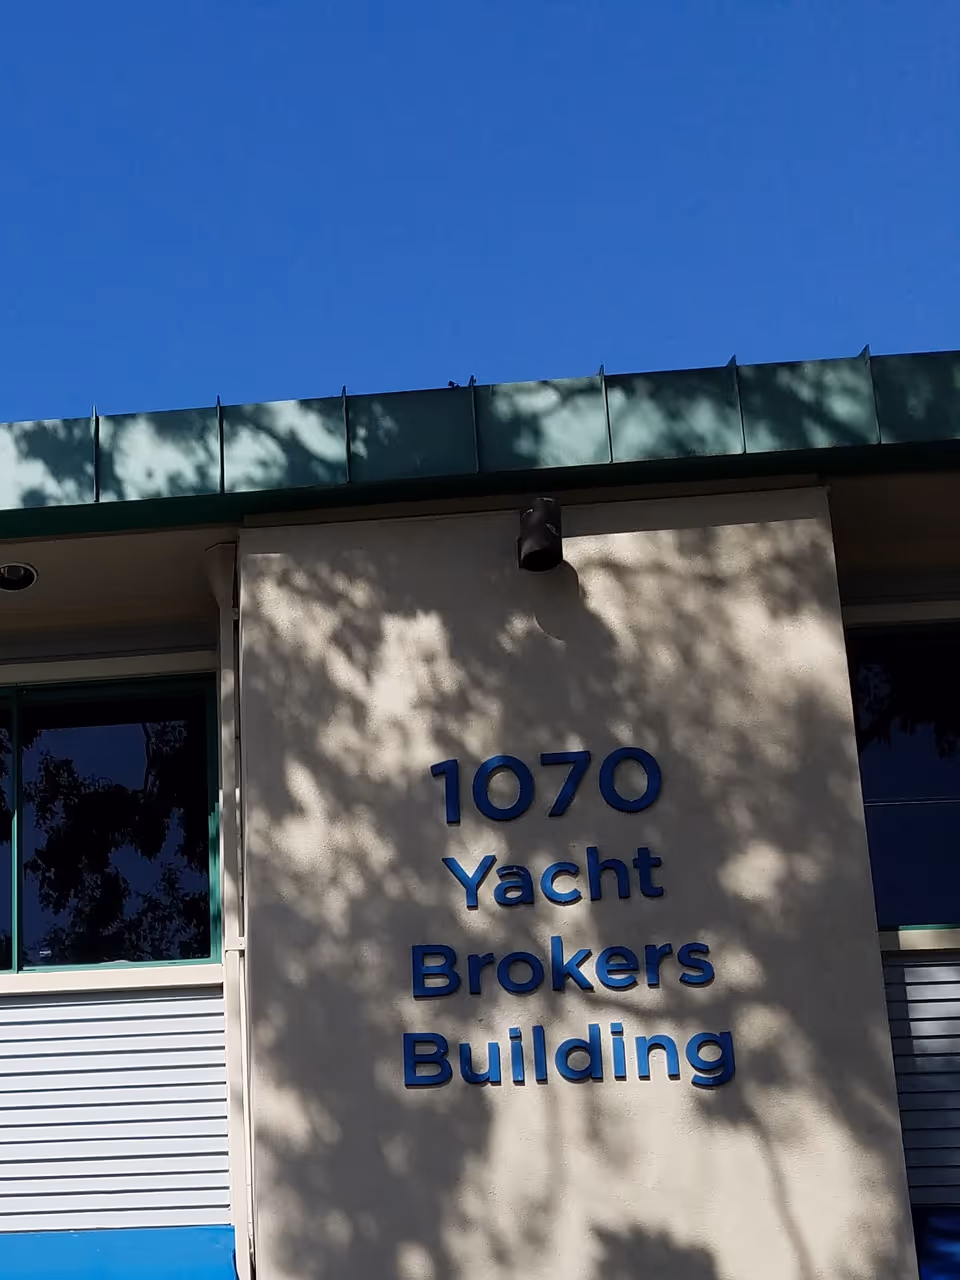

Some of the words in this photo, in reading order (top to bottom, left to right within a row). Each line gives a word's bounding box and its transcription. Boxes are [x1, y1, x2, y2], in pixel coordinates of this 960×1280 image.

[430, 746, 662, 825] 1070
[442, 846, 664, 910] Yacht
[412, 936, 715, 1000] Brokers
[403, 1022, 736, 1089] Building
